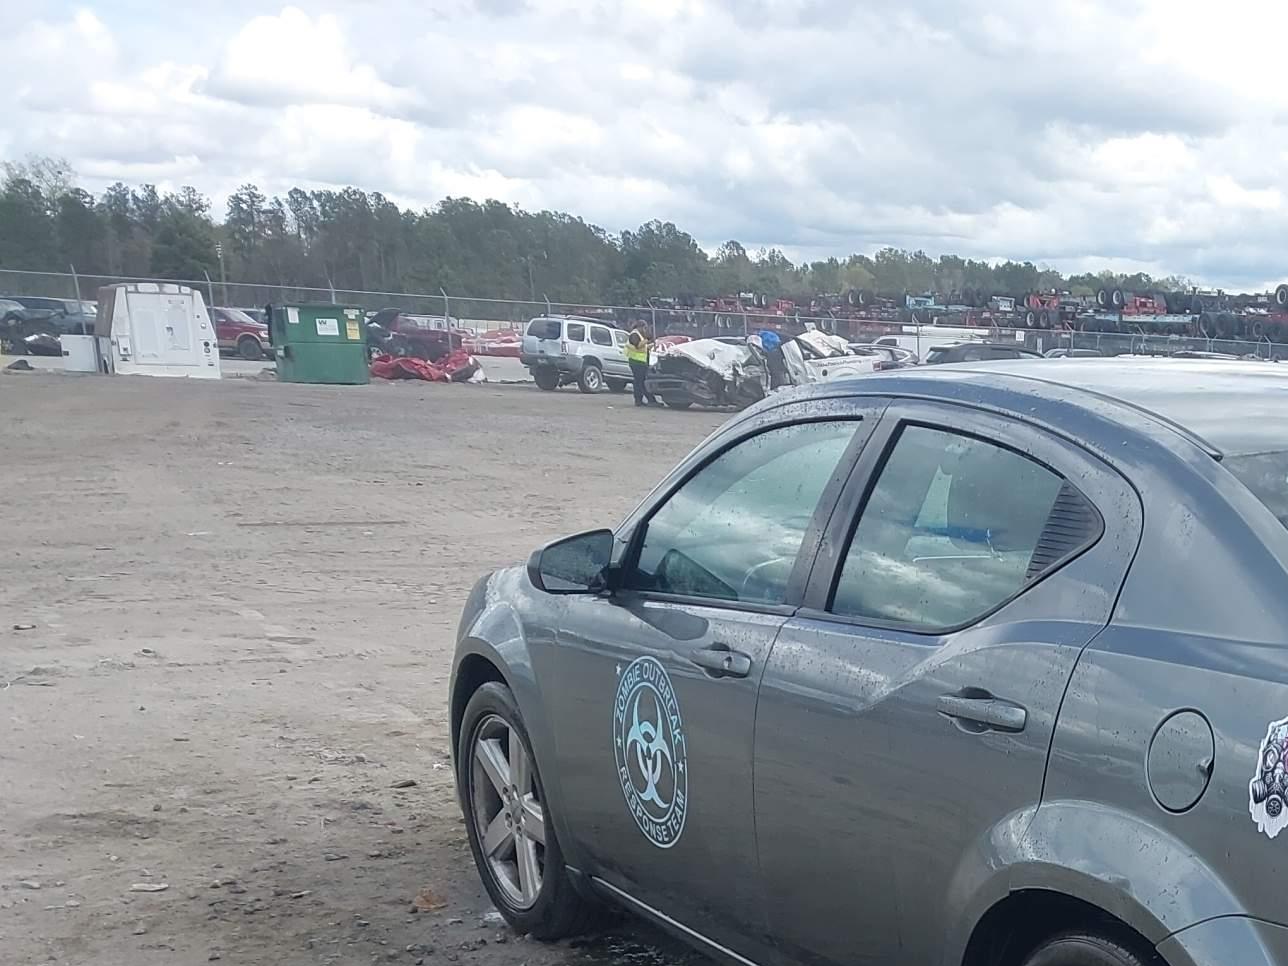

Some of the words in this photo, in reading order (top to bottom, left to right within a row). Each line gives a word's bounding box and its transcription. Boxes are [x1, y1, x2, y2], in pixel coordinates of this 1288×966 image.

[615, 662, 641, 721] ZOMBIE
[642, 662, 683, 745] OUTBREAK
[619, 766, 670, 842] RESPONSE
[668, 790, 685, 838] TEAM
